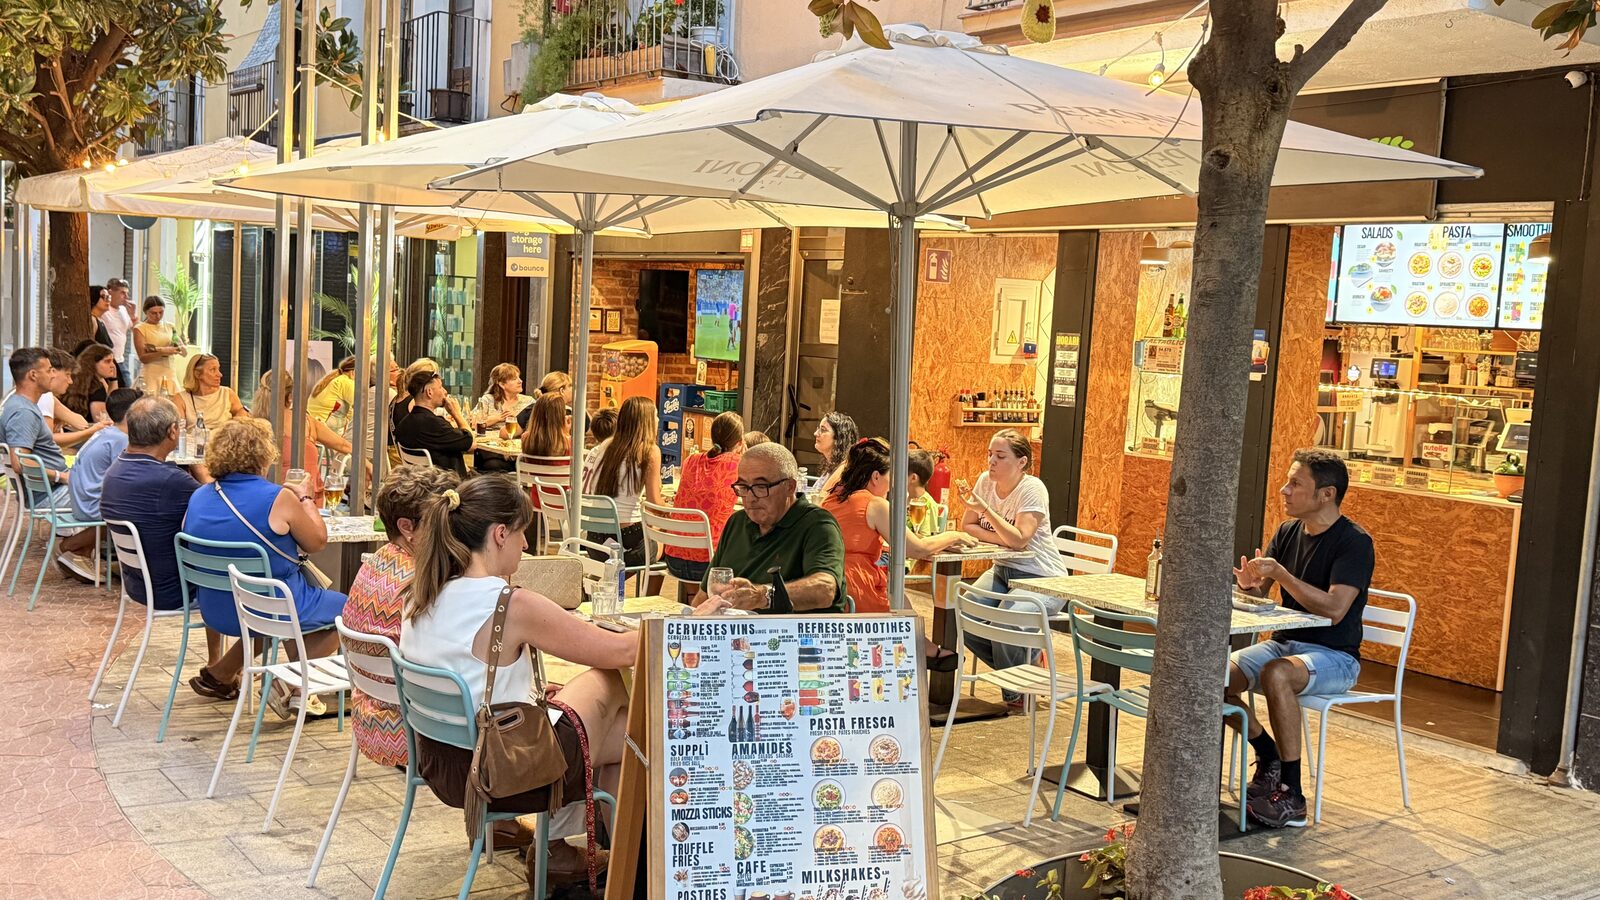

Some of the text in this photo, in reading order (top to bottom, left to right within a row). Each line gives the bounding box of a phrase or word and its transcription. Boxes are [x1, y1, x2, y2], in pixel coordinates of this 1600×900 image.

[1362, 226, 1394, 239] SALADS
[1442, 226, 1472, 238] PASTA
[511, 236, 543, 246] storage
[523, 245, 542, 254] here
[519, 263, 544, 272] bounce
[1424, 444, 1448, 452] nutella
[668, 623, 727, 635] CERVESES
[730, 624, 755, 635] VINS
[798, 622, 844, 634] REFRESC
[846, 621, 911, 634] SMOOTIHES
[810, 718, 846, 730] PASTA
[851, 716, 895, 729] FRESCA
[670, 741, 708, 756] SUPPLÌ
[732, 742, 792, 756] AMANIDES
[672, 807, 732, 821] MOZZA STICKS
[672, 842, 714, 855] TRUFFLE
[673, 854, 700, 867] FRIES
[737, 860, 766, 874] CAFE
[802, 867, 880, 884] MILKSHAKES
[678, 889, 726, 900] POSTRES
